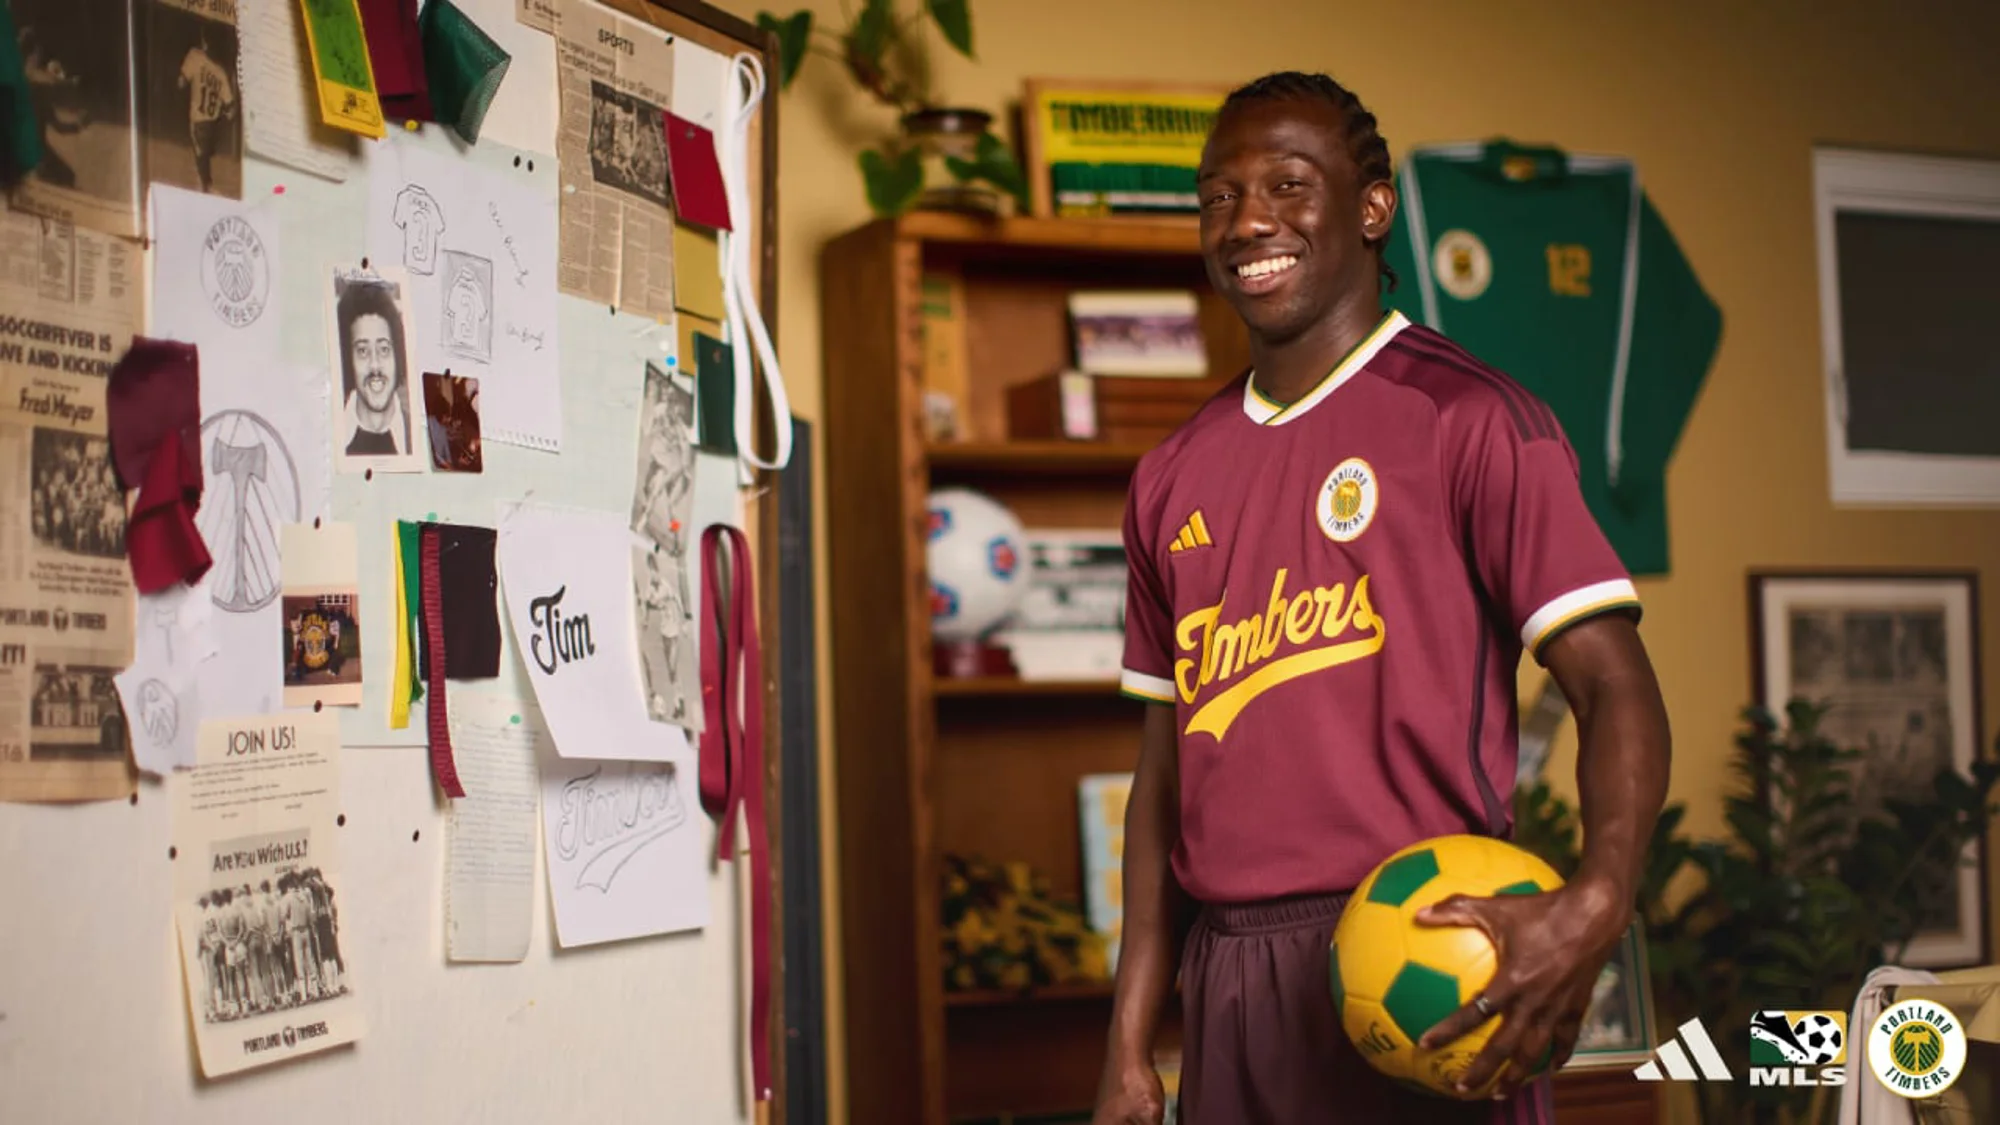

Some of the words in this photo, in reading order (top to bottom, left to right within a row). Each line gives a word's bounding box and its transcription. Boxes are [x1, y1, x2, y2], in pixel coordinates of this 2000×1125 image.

[598, 28, 635, 56] SPORTS
[1545, 245, 1591, 297] 12
[99, 334, 113, 353] IS
[28, 347, 60, 370] AND
[62, 354, 114, 378] KICKIN
[19, 387, 51, 415] Fred
[52, 393, 95, 427] Meyer
[1327, 467, 1368, 492] PORTLAND
[1326, 511, 1365, 533] TIMBERS
[530, 584, 595, 676] Tim
[226, 729, 265, 757] JOIN
[271, 724, 296, 751] US!
[213, 852, 233, 873] Are
[243, 1032, 282, 1056] PORTLAND
[296, 1020, 329, 1042] TIMBERS
